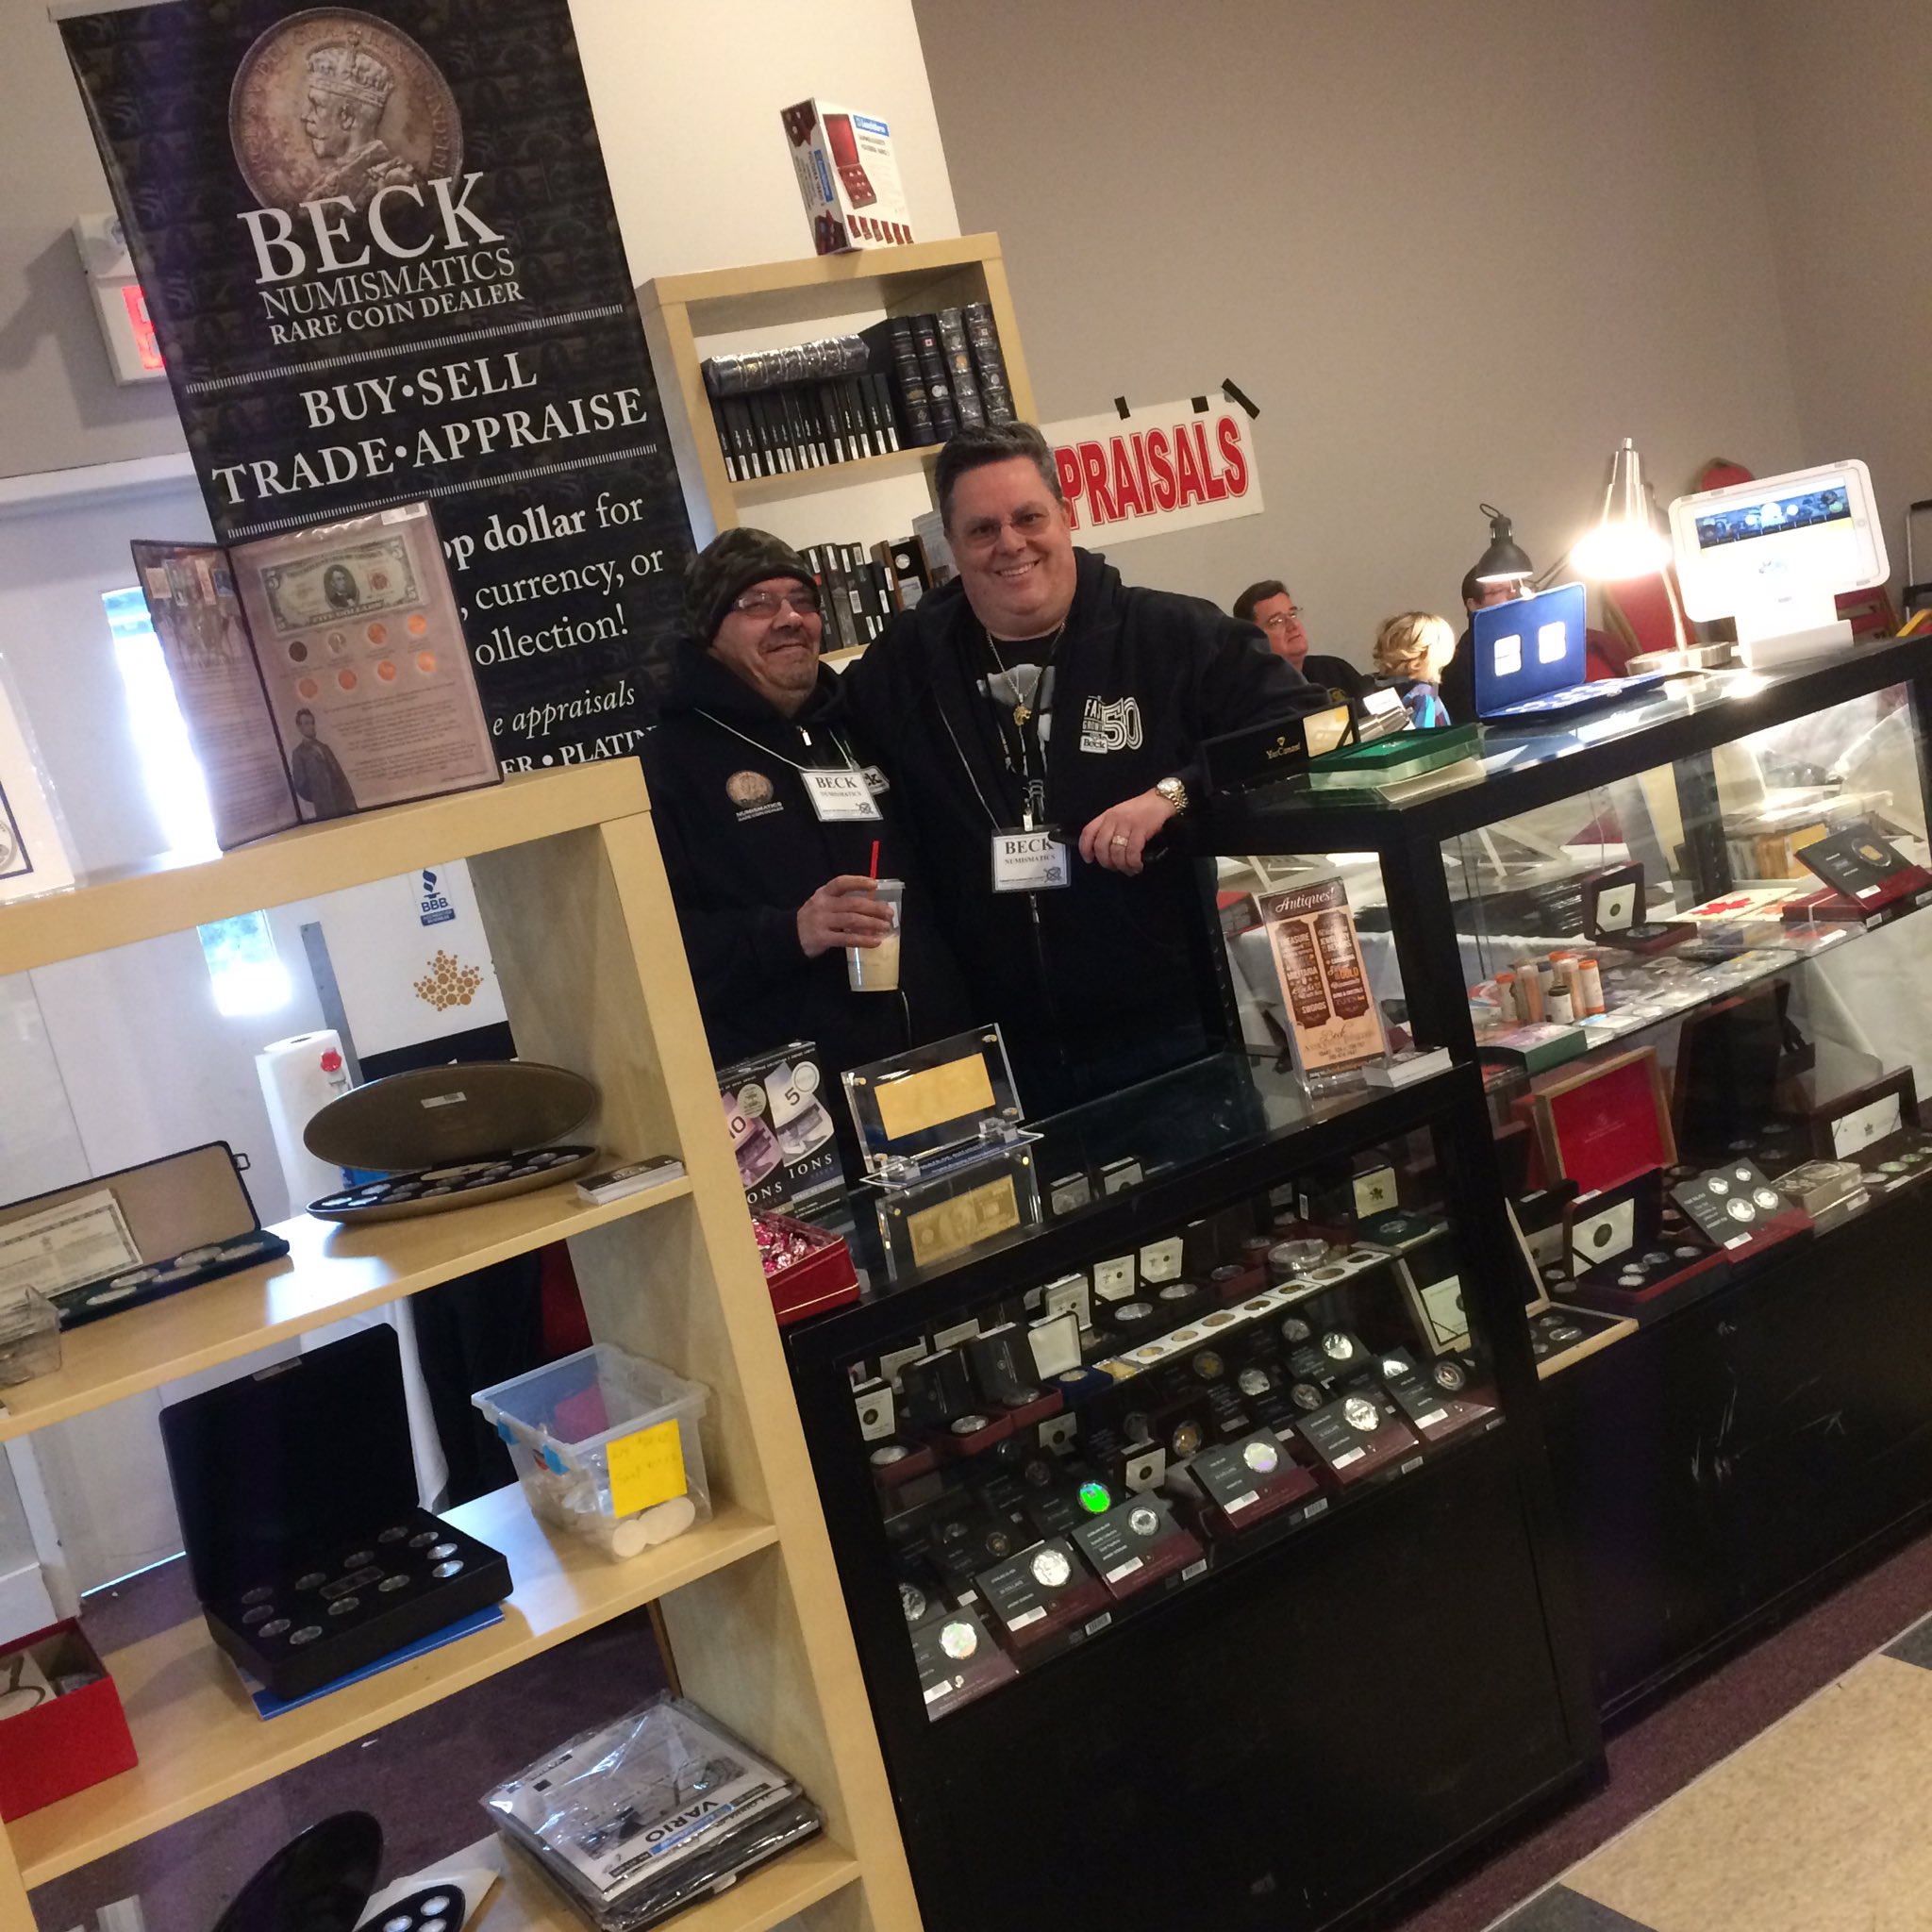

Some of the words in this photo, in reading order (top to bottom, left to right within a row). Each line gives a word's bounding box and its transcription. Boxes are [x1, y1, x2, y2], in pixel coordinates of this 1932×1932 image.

[237, 172, 505, 285] BECK
[259, 248, 515, 319] NUMISMATICS
[270, 309, 342, 344] RARE
[345, 296, 414, 330] COIN
[423, 281, 525, 319] DEALER
[1053, 415, 1249, 530] PRAISALS
[484, 505, 586, 552] dollar
[596, 492, 643, 528] for
[475, 560, 625, 610] currency,
[631, 550, 663, 575] or
[475, 603, 628, 665] ollection!
[512, 680, 635, 740] appraisals
[1103, 697, 1142, 750] 50
[559, 725, 657, 765] PLATI
[1084, 738, 1106, 748] Beck
[815, 776, 858, 789] BECK
[736, 802, 783, 818] NUMISMATICS
[1005, 838, 1055, 855] BECK
[1005, 855, 1056, 865] NUMISMATICS
[421, 897, 449, 912] BBB
[1275, 887, 1336, 913] Antiques!
[1302, 1001, 1327, 1014] SWORDS
[784, 1087, 800, 1106] 5
[789, 1153, 832, 1179] IONS
[746, 1181, 783, 1204] ONS
[645, 1800, 719, 1843] VARIO
